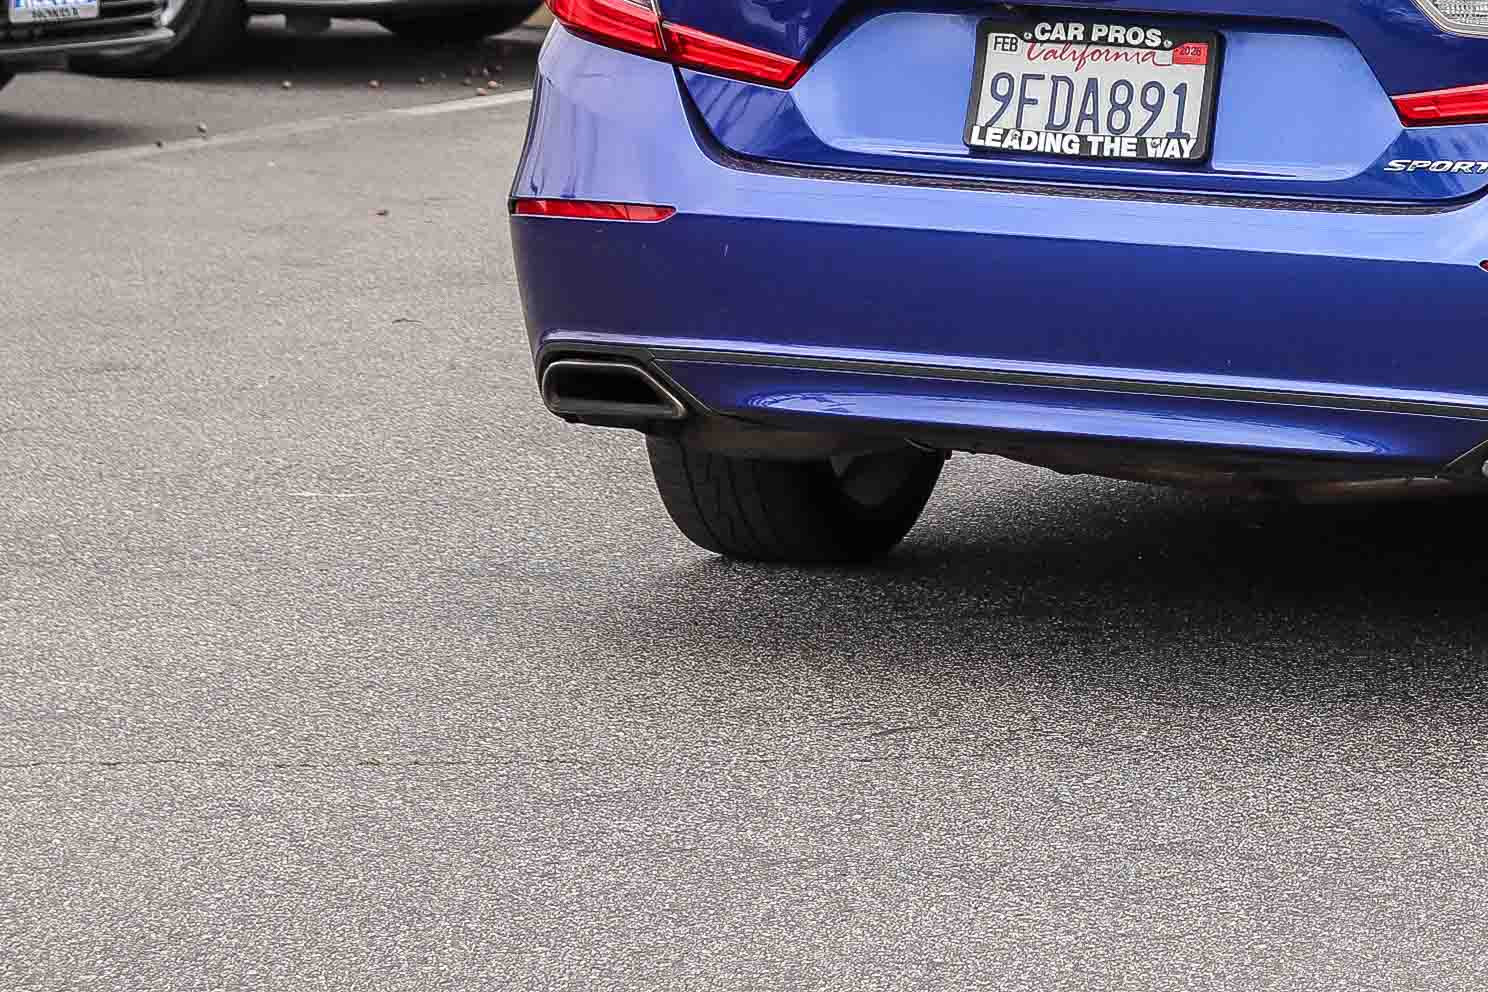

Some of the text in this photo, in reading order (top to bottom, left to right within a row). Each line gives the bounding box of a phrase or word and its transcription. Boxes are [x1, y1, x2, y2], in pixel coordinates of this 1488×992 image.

[994, 35, 1019, 52] FEB
[1034, 22, 1162, 47] CAR PROS
[1026, 41, 1171, 72] California
[985, 72, 1190, 139] 9FDA891
[970, 125, 1196, 158] LEADING THE WAY
